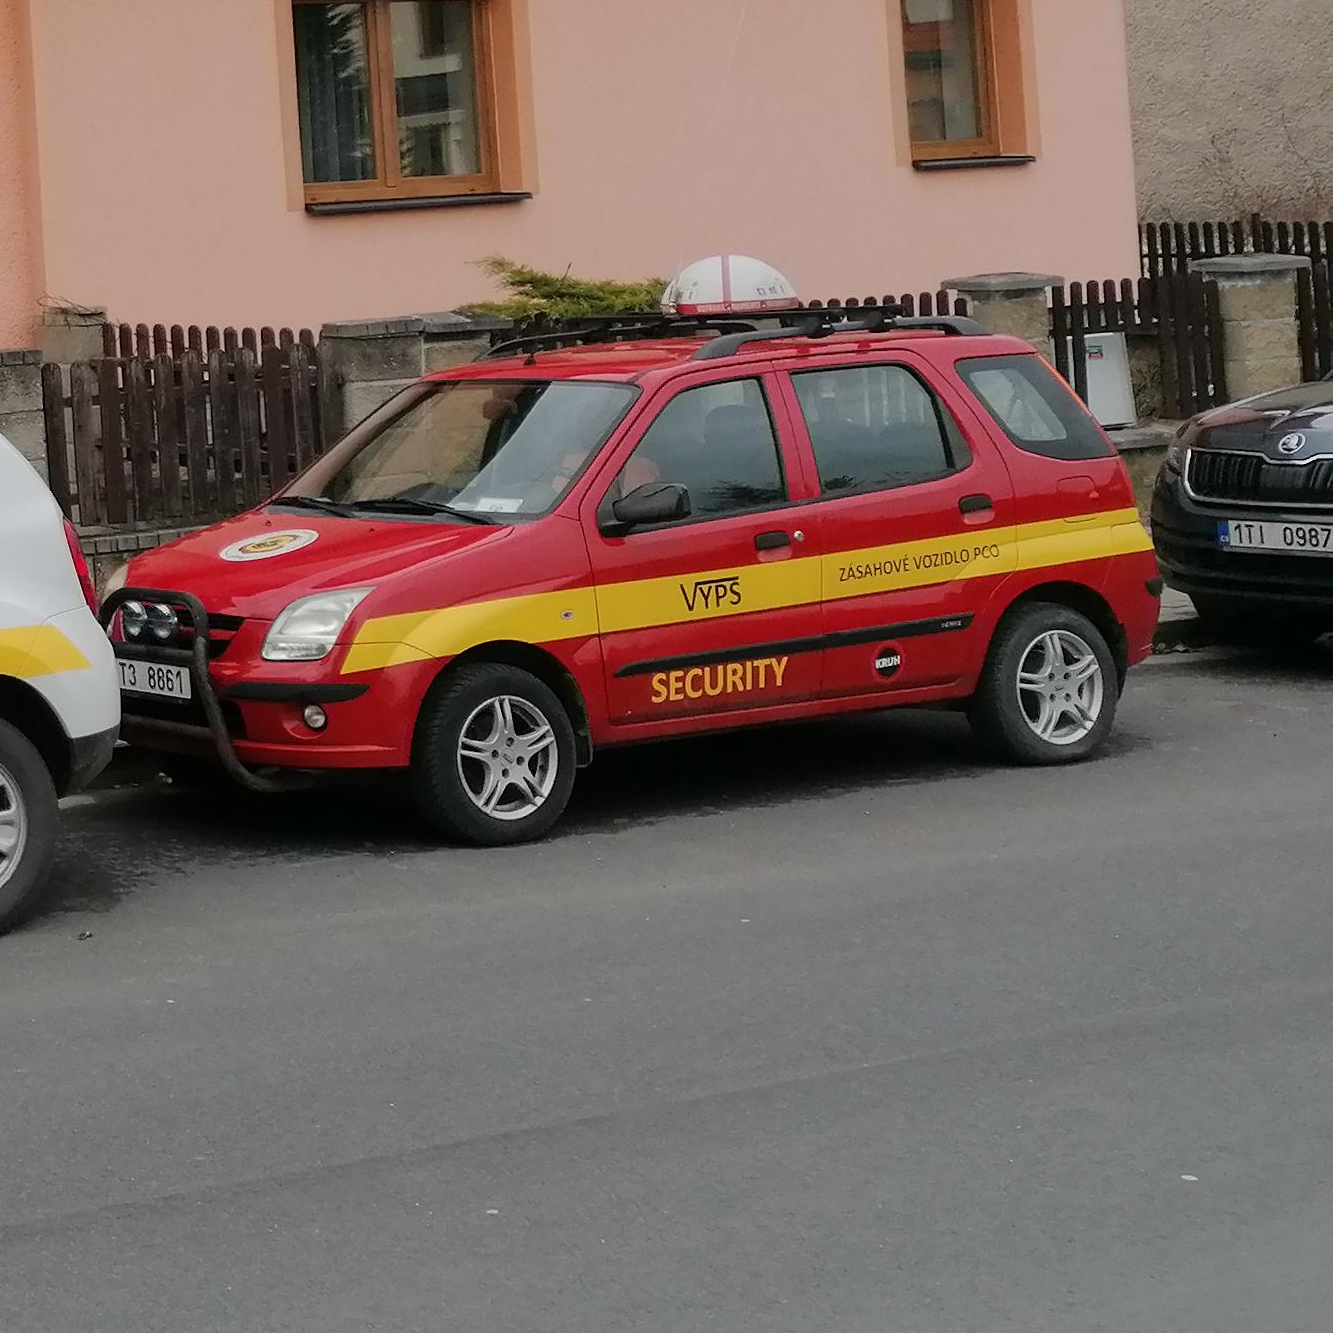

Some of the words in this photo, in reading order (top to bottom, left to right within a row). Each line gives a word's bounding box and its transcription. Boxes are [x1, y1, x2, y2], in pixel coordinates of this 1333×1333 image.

[1284, 526, 1331, 548] 0987
[839, 554, 910, 582] ZÁSAHOVÉ
[913, 549, 970, 570] VOZIDLO
[973, 544, 999, 560] PCO
[680, 576, 741, 611] VYPS
[118, 662, 136, 685] T3
[148, 666, 183, 694] 8861
[651, 656, 789, 703] SECURITY
